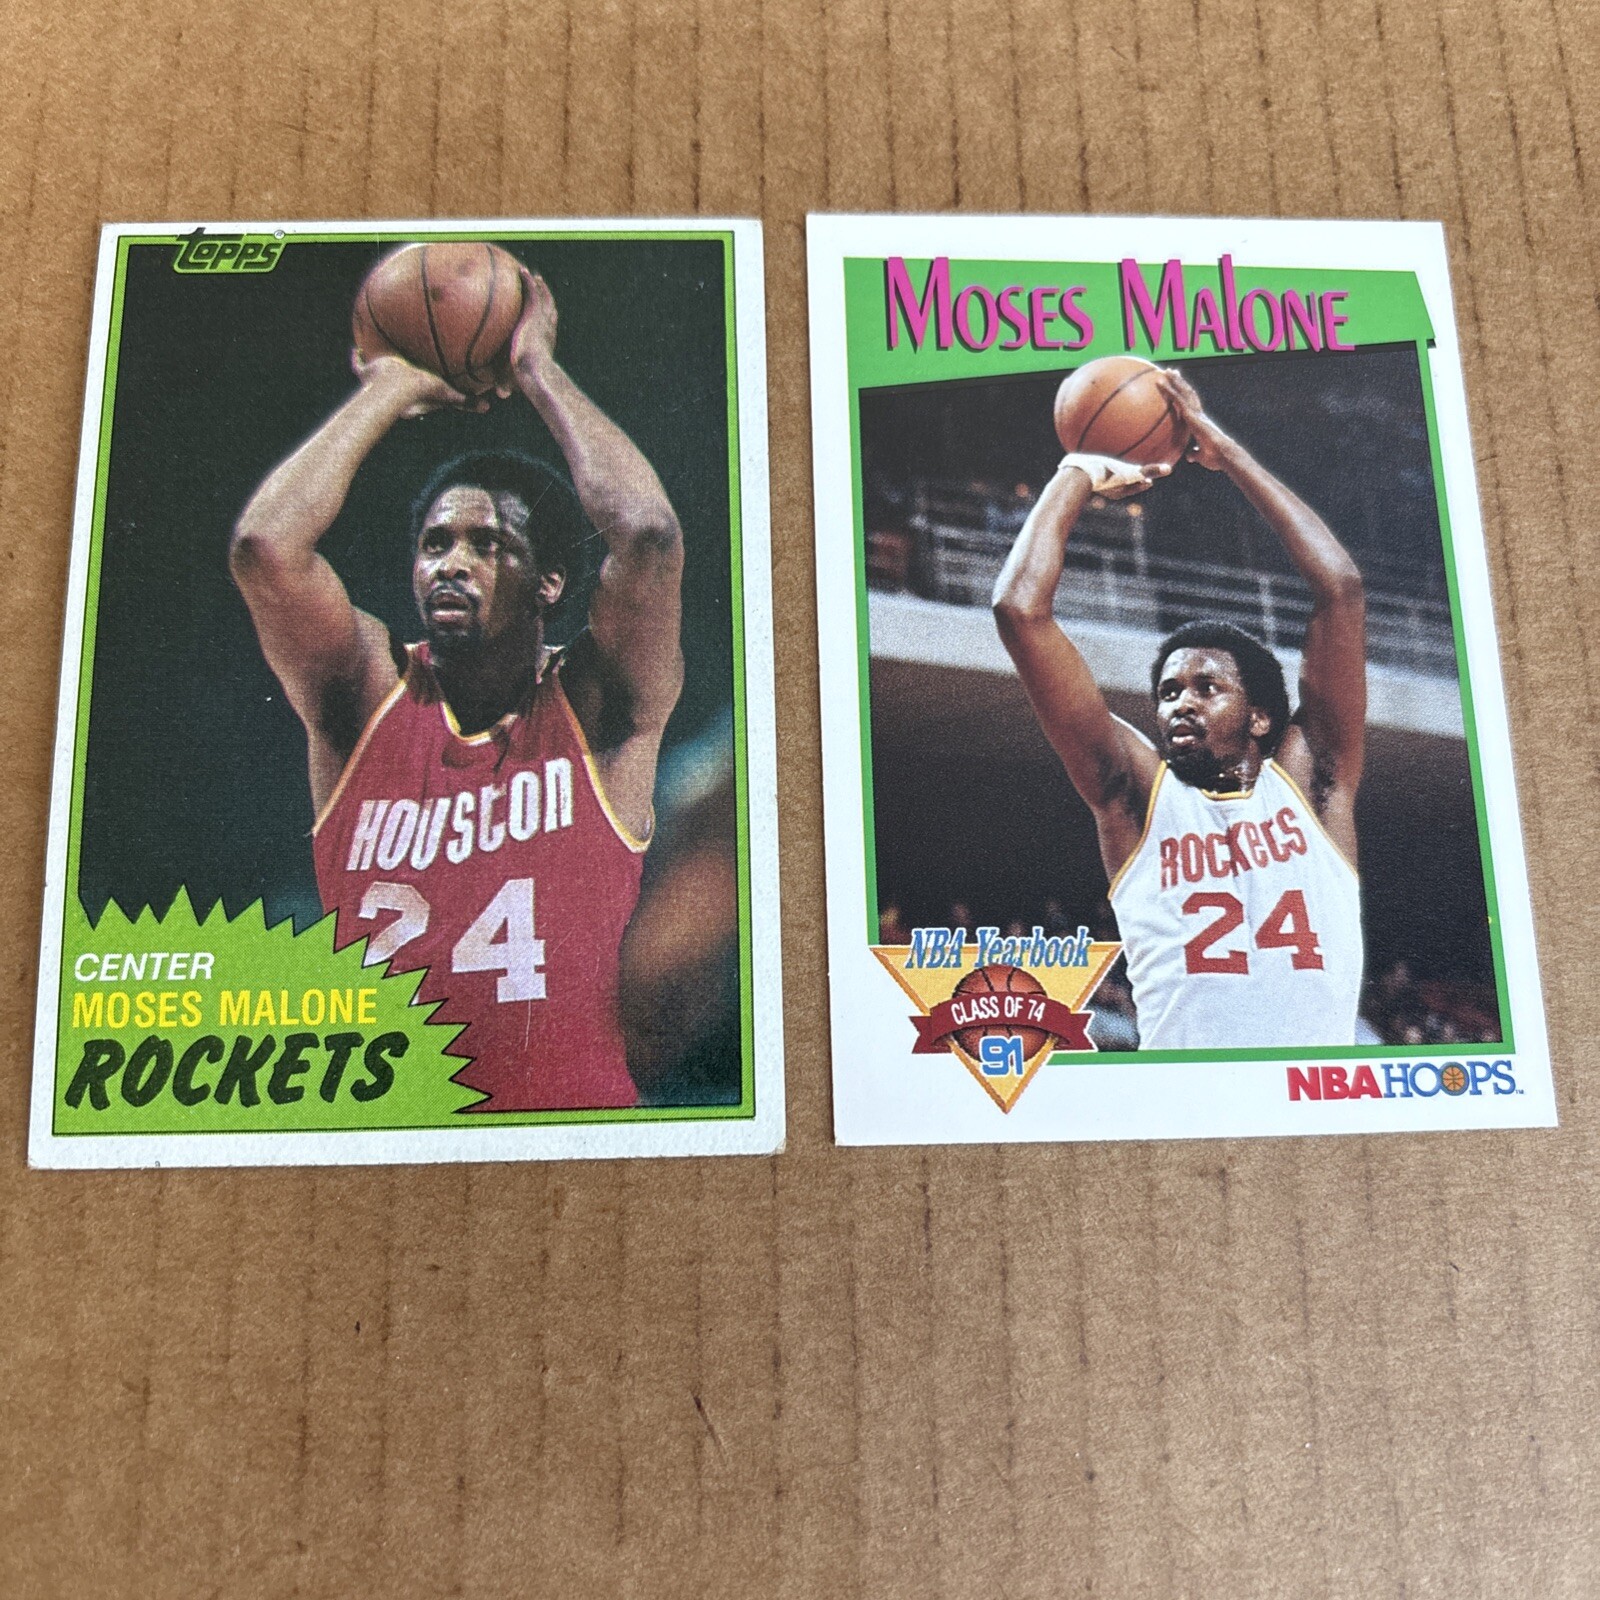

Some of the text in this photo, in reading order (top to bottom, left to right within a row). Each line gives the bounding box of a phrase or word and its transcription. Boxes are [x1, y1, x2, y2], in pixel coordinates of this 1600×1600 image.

[176, 226, 283, 270] topps
[905, 927, 1093, 969] NBA Yearbook
[1182, 889, 1325, 975] 24
[74, 952, 215, 983] CENTER
[72, 987, 378, 1029] MOSES MALONE
[951, 995, 1046, 1025] CLASS OF 74
[64, 1032, 411, 1111] ROCKETS
[980, 1037, 1024, 1076] 91
